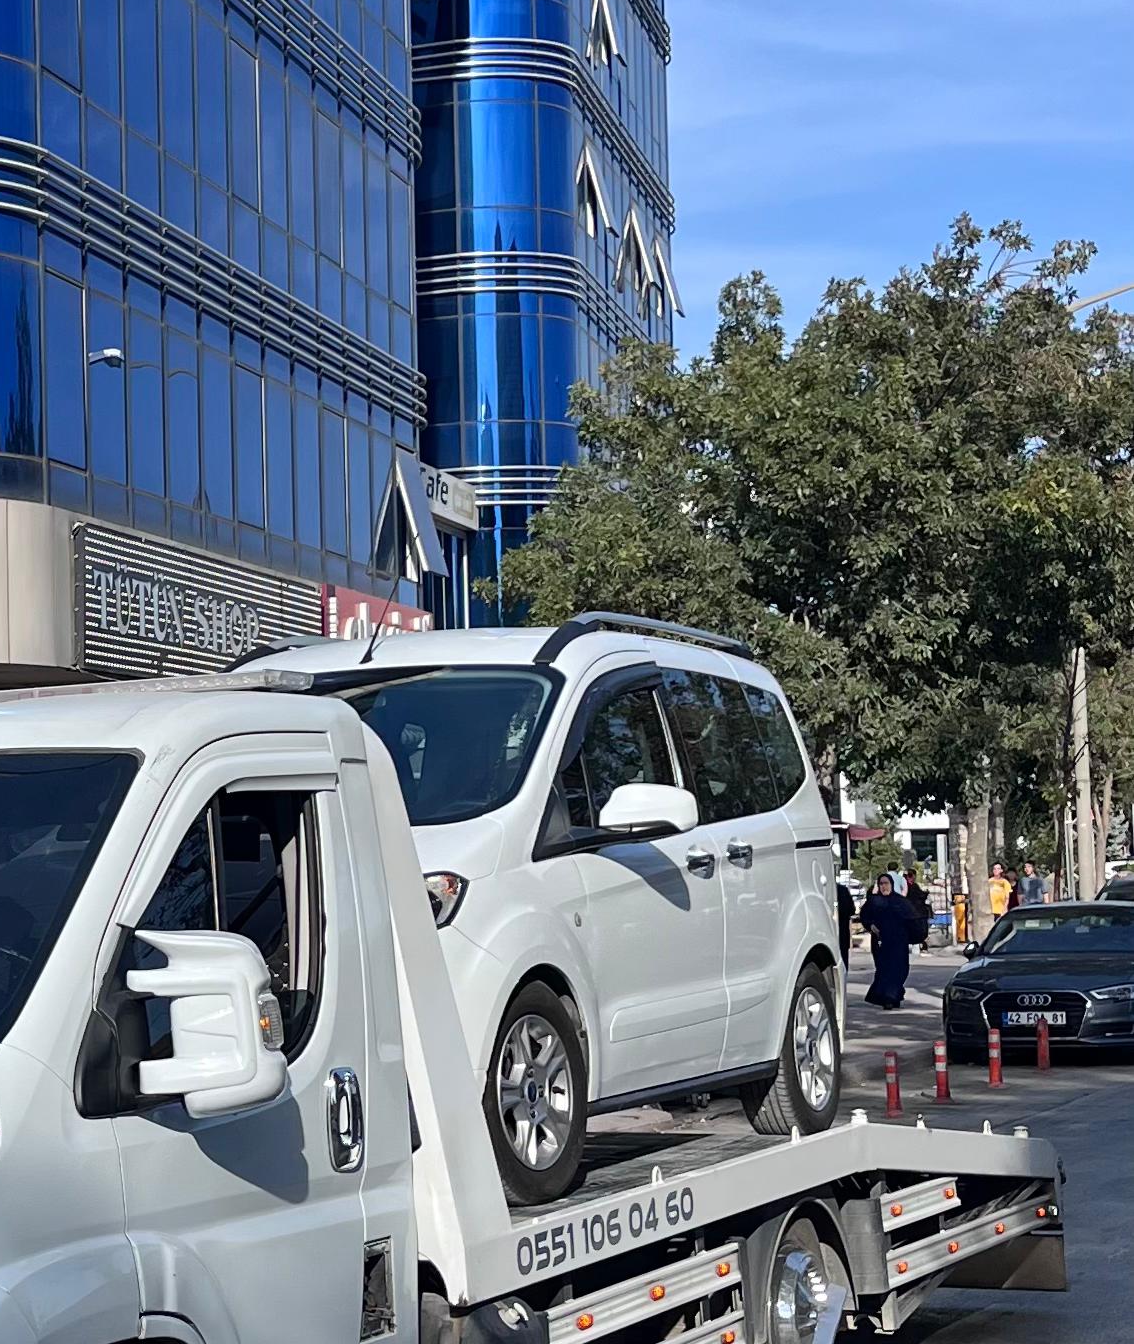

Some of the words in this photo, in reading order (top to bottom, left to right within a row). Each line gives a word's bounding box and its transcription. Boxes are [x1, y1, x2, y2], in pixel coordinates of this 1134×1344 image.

[419, 468, 449, 505] afe
[93, 562, 185, 649] TÜTÜN
[193, 595, 260, 656] SHOP
[1009, 1013, 1021, 1024] 42
[517, 1222, 575, 1276] 0551
[581, 1208, 622, 1255] 106
[629, 1197, 659, 1238] 04
[666, 1186, 694, 1226] 60
